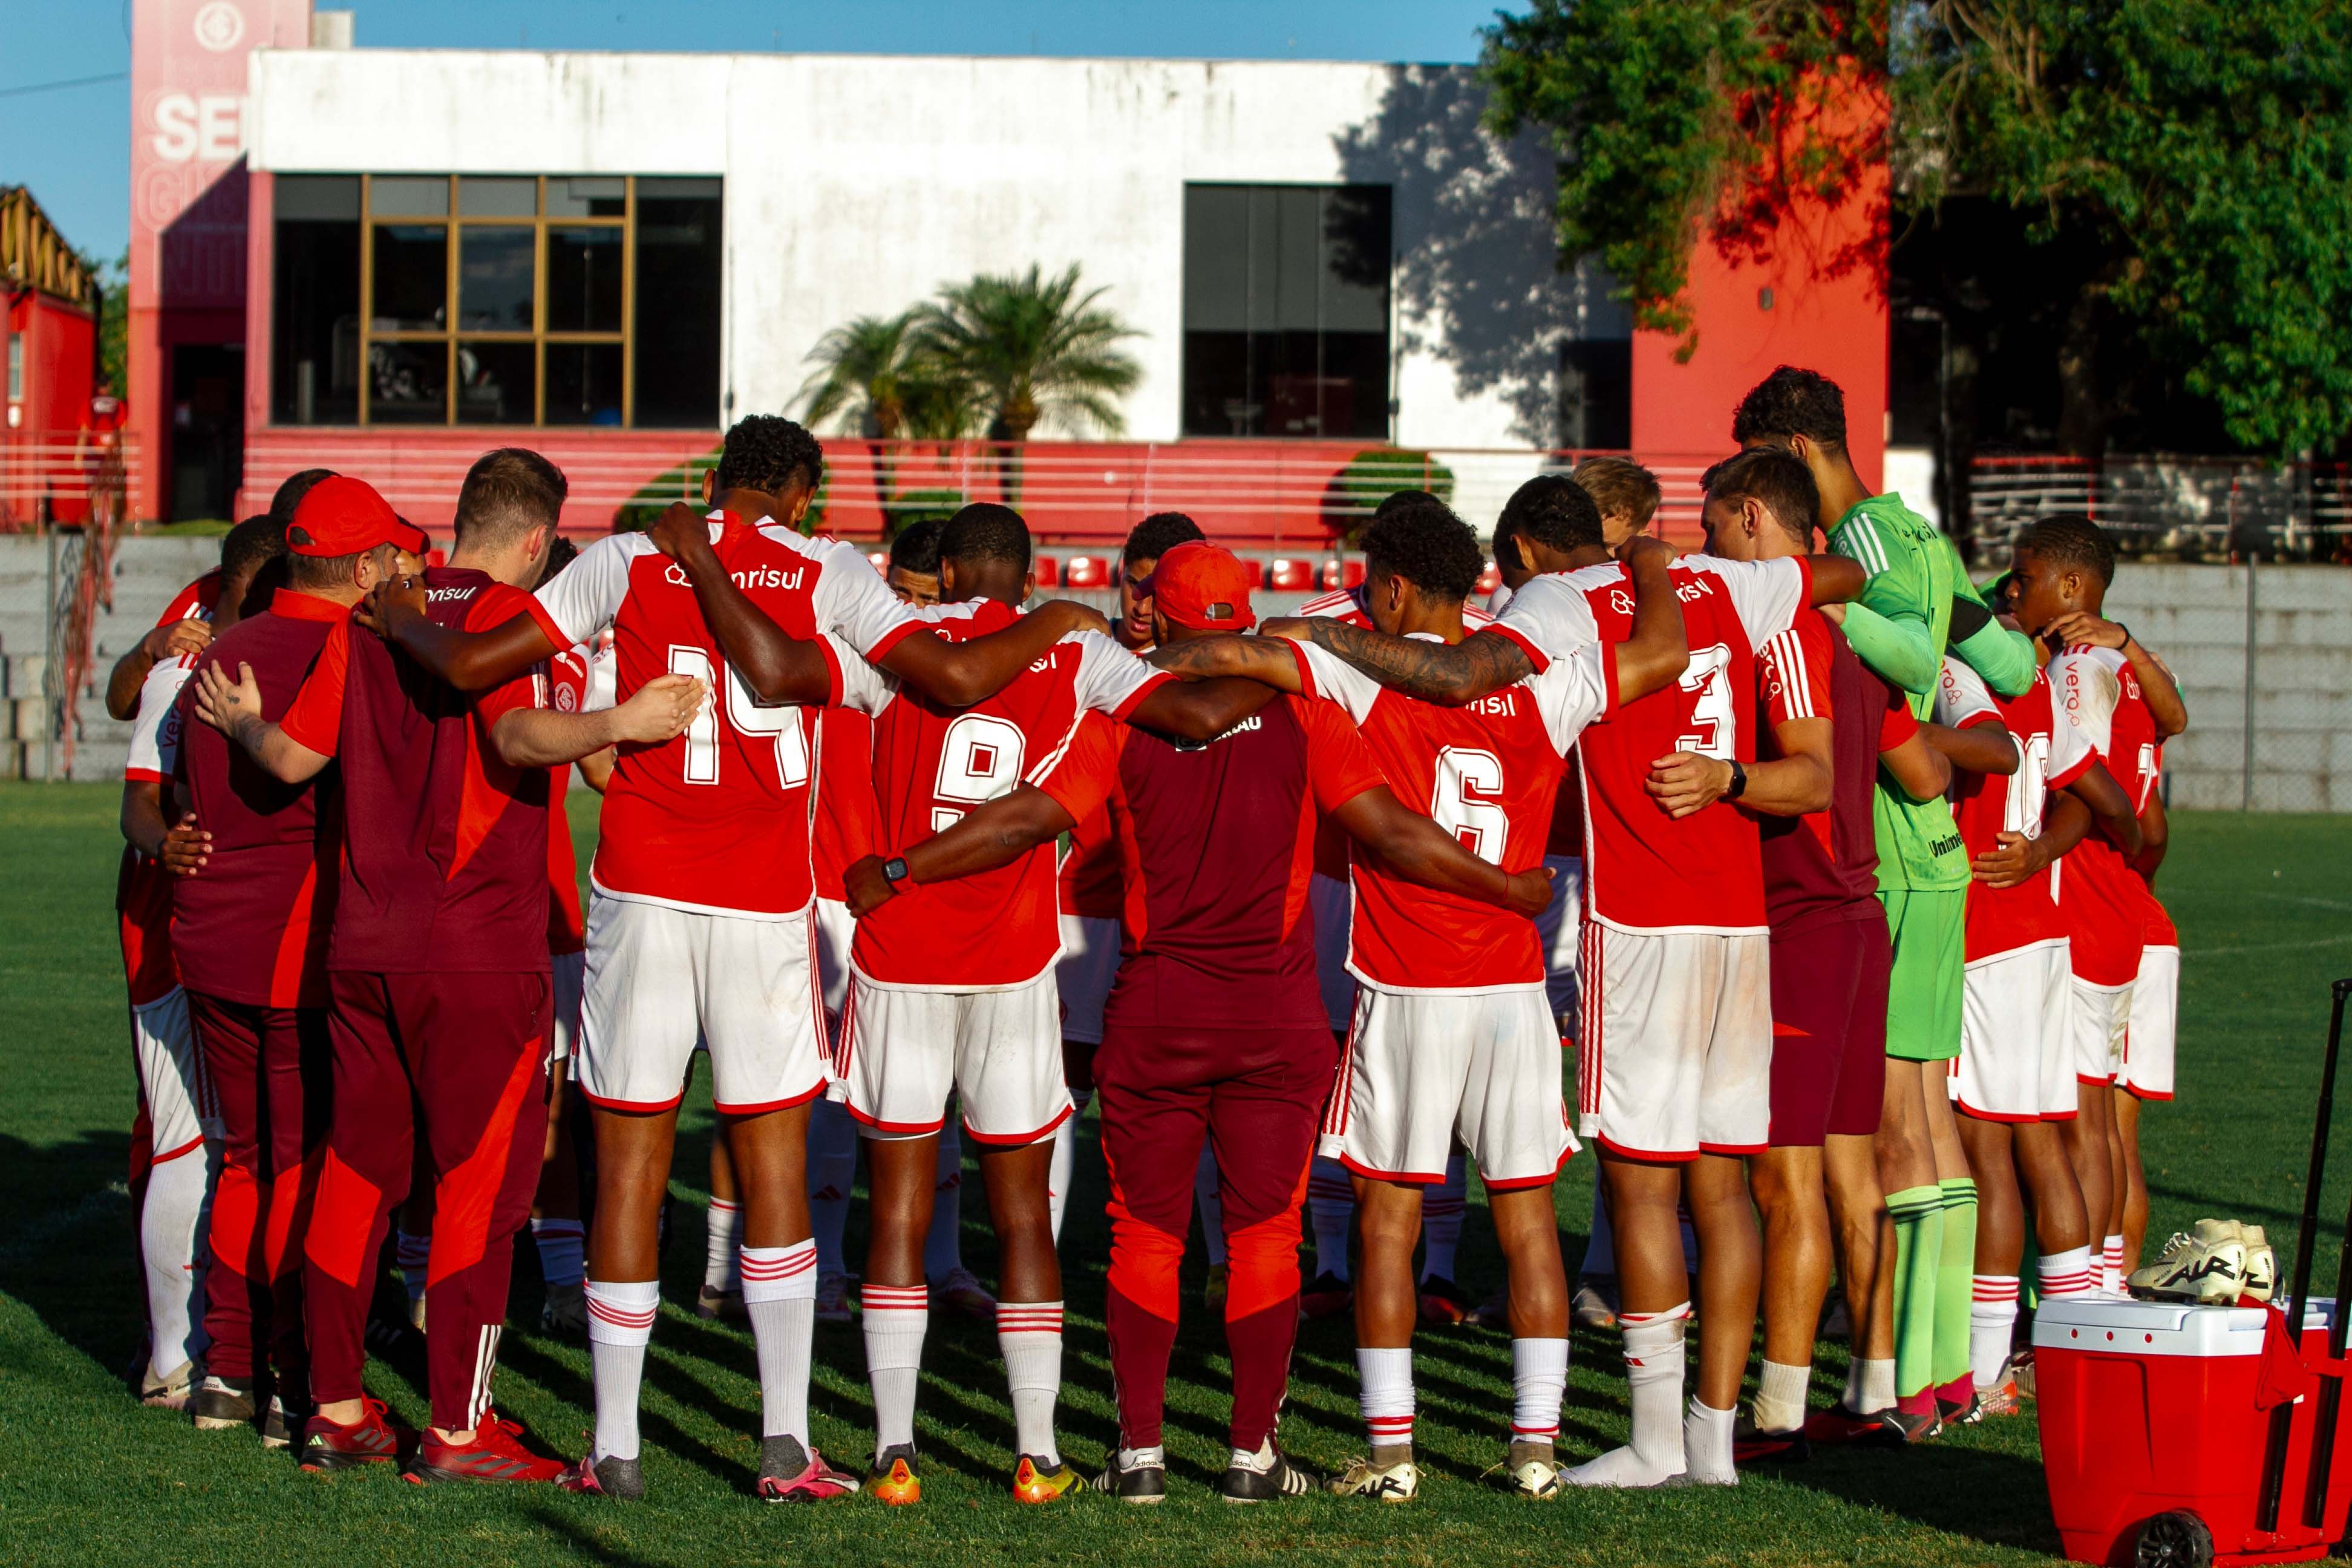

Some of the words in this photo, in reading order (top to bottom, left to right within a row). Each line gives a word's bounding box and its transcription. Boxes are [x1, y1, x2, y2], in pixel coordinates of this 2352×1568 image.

[155, 94, 249, 162] SE
[1674, 642, 1736, 761] 3
[2065, 661, 2080, 710] vero
[1431, 744, 1510, 866] 6
